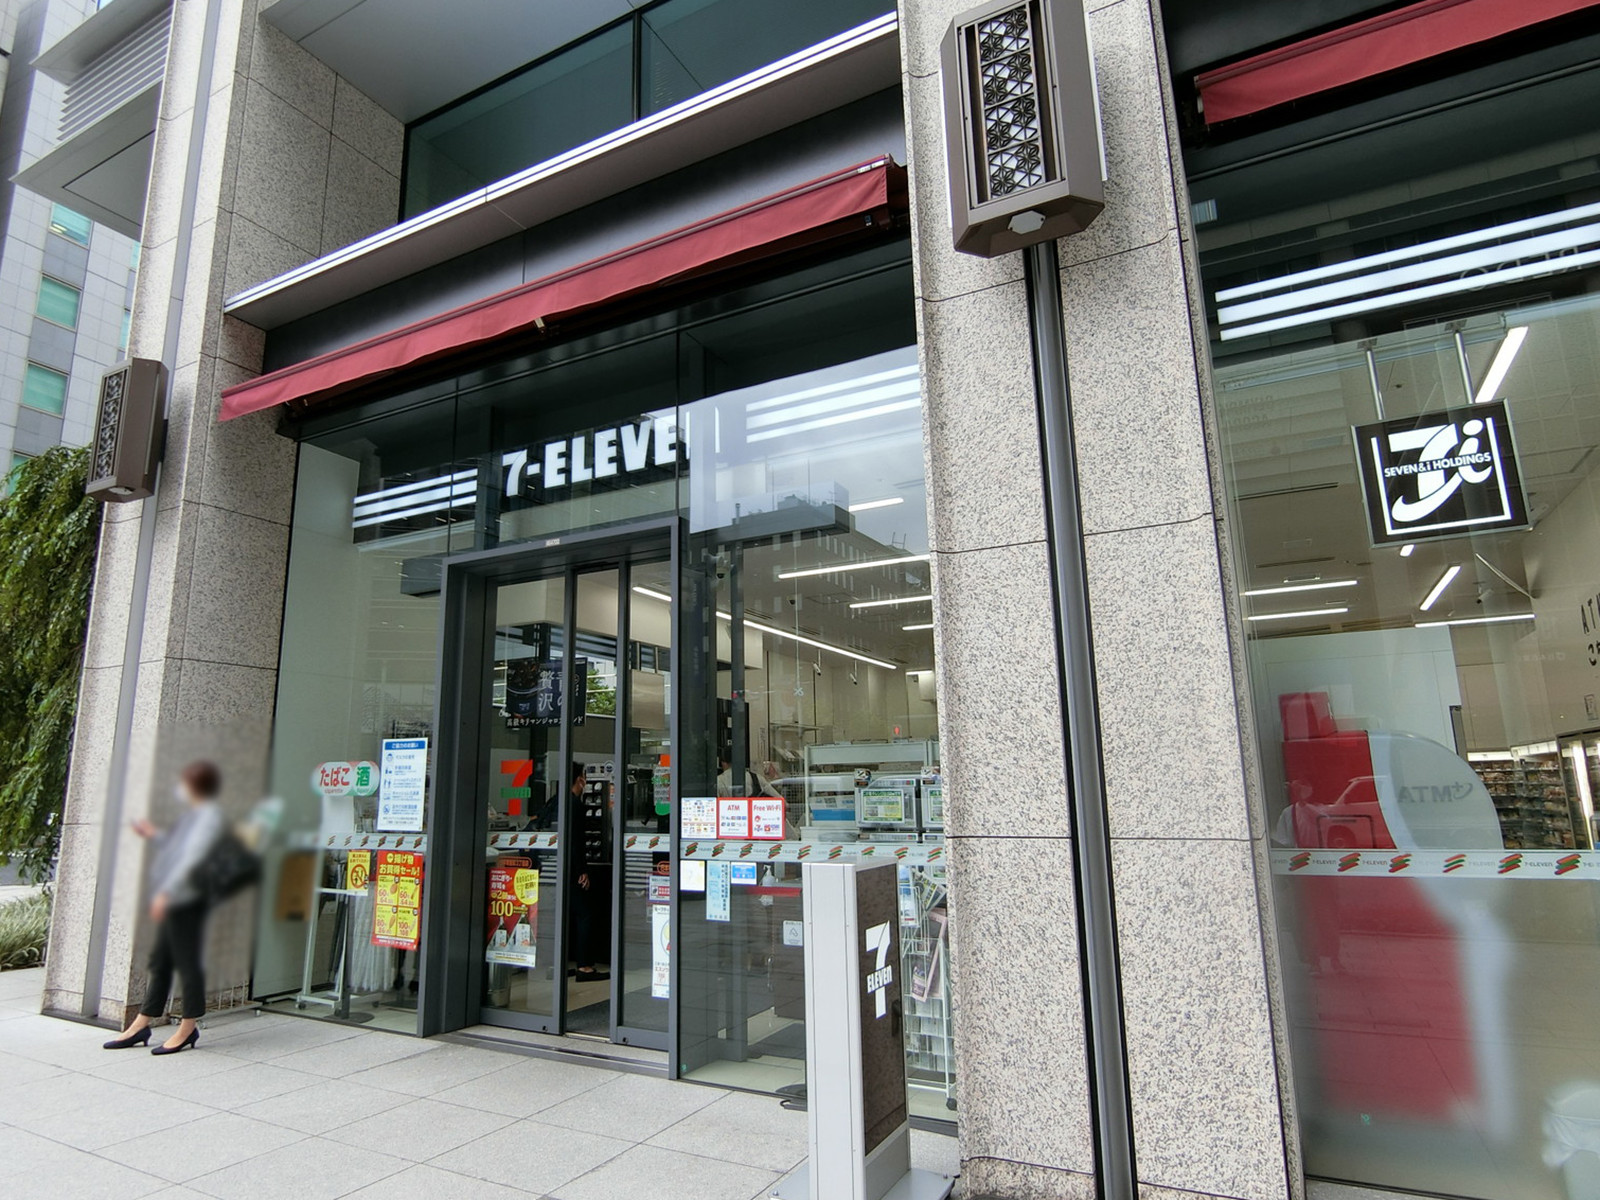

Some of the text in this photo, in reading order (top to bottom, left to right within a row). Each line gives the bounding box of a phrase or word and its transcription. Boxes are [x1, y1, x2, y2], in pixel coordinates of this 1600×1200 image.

[1433, 451, 1492, 469] HOLDINGS
[320, 766, 350, 787] たばこ
[356, 766, 371, 787] 酒
[491, 901, 513, 917] 100
[866, 919, 892, 1019] 7
